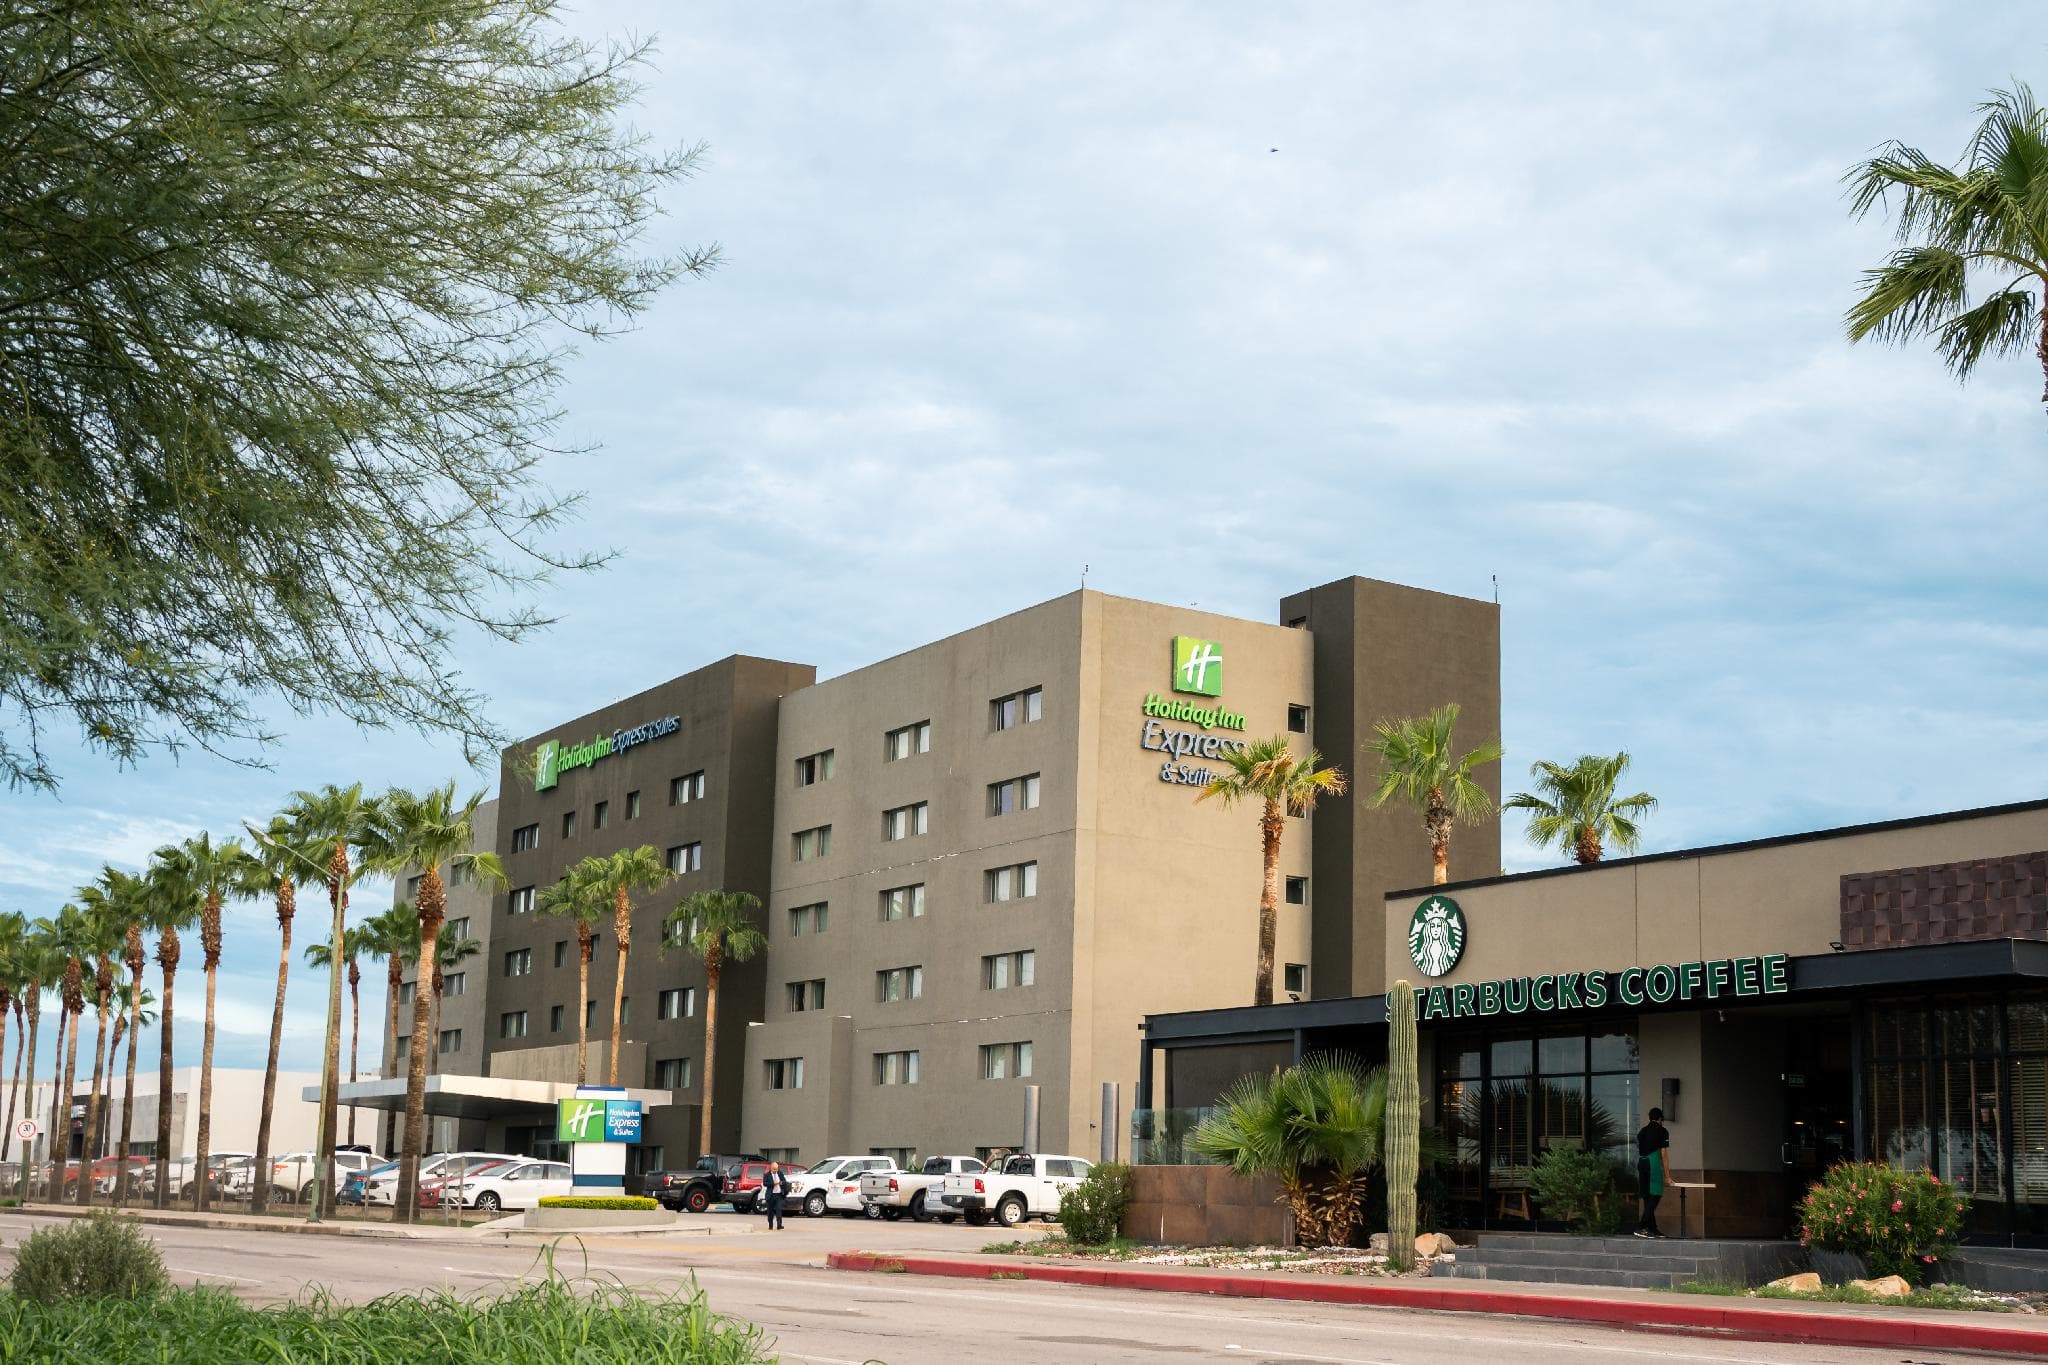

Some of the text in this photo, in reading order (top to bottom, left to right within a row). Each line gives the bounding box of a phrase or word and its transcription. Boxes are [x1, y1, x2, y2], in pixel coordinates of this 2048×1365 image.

[1143, 693, 1246, 730] Holiday Inn
[558, 740, 594, 773] Holiday
[594, 734, 611, 760] Inn
[611, 724, 649, 755] Express
[1160, 761, 1178, 782] &
[1619, 953, 1788, 1006] COFFEE
[609, 1117, 640, 1128] Express
